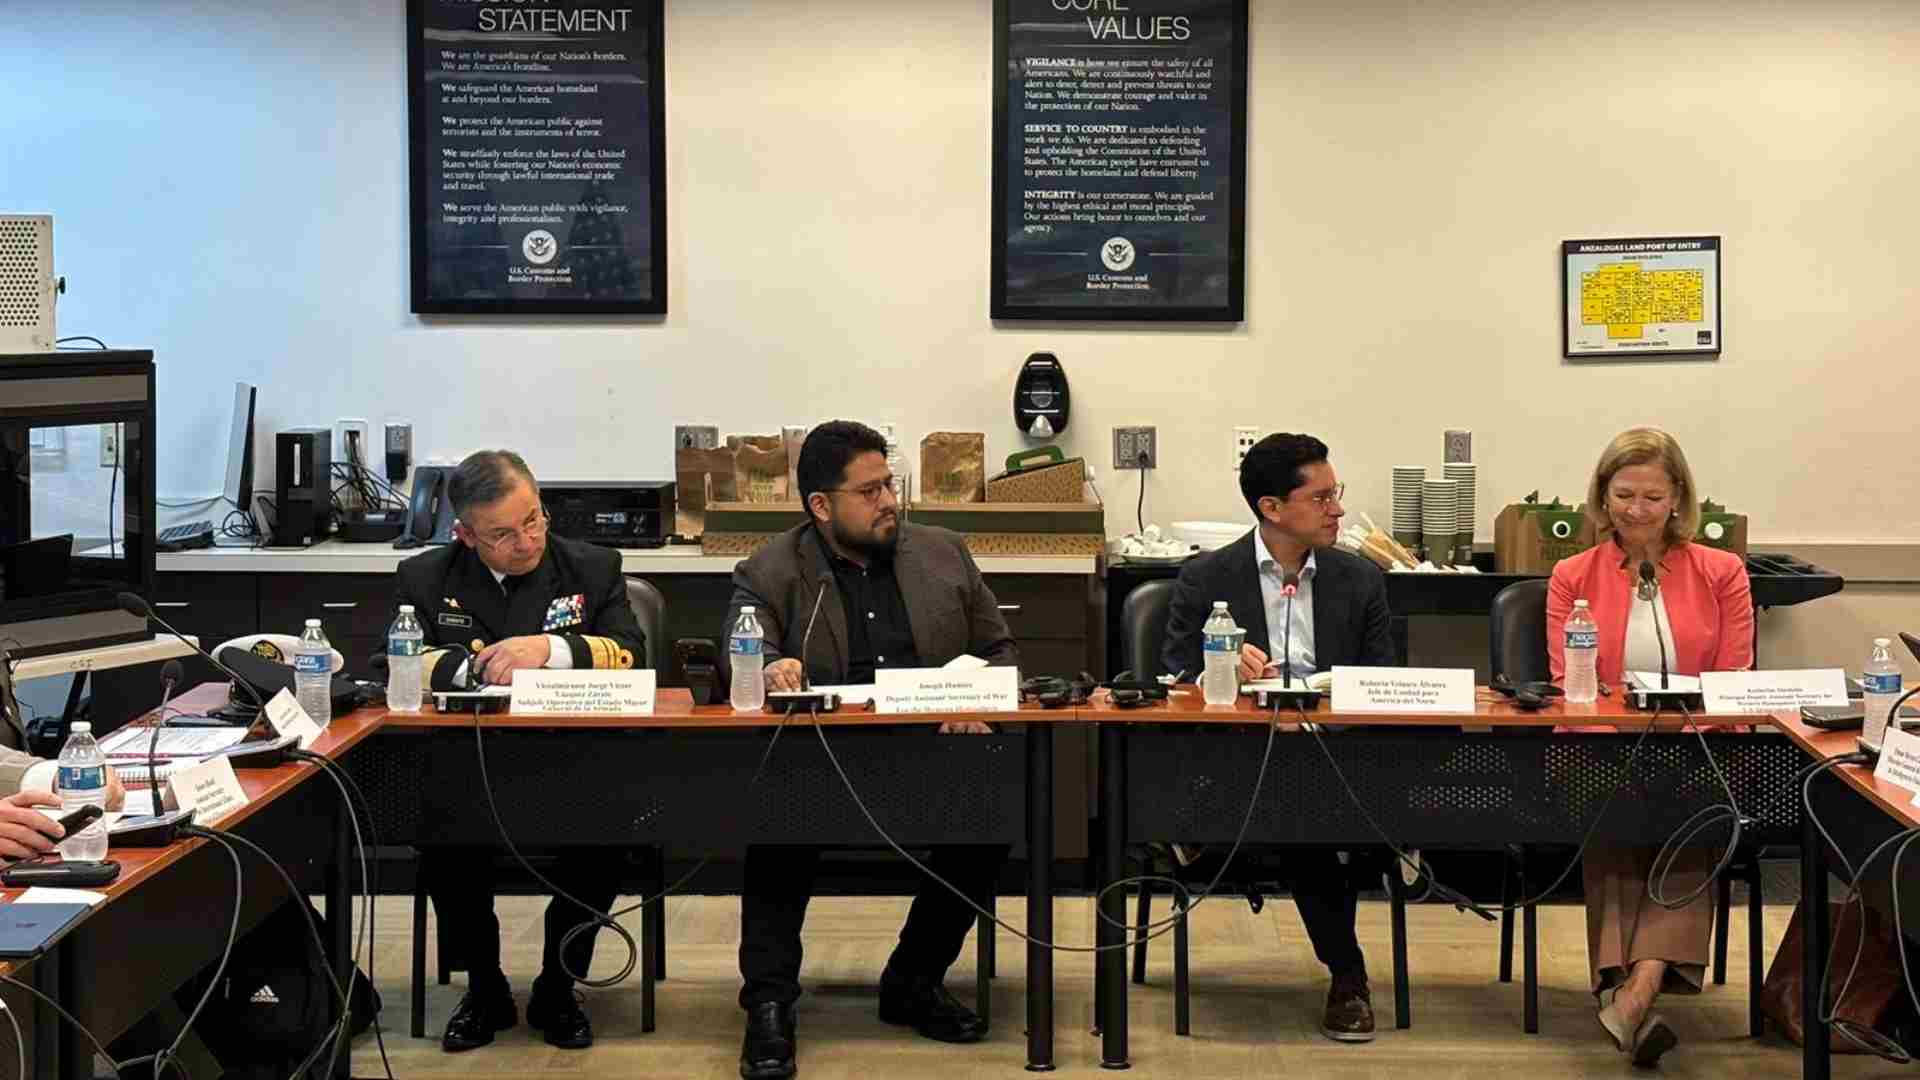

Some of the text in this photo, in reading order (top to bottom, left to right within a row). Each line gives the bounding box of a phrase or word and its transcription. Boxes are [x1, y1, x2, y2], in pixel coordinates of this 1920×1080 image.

[478, 8, 632, 32] STATEMENT
[1086, 16, 1190, 40] VALUES
[488, 51, 627, 61] guardians Nation's borders.
[1026, 58, 1076, 67] VIGILANCE
[1086, 58, 1104, 67] how
[1152, 58, 1165, 67] the
[1168, 58, 1188, 69] safety
[1025, 70, 1210, 80] Americans. continuously watchful and
[458, 84, 598, 94] safeguard the American homeland
[1124, 81, 1154, 90] prevent
[470, 95, 552, 105] beyond borders.
[1025, 92, 1054, 100] Nation.
[1124, 93, 1155, 102] courage
[1158, 92, 1172, 100] and
[1024, 102, 1140, 112] the protection Nation.
[460, 116, 602, 127] protect the American public against
[442, 128, 479, 136] terrorists
[482, 128, 496, 136] and
[499, 128, 510, 136] the
[514, 128, 562, 136] instruments
[1024, 124, 1206, 134] SERVICE TO COUNTRY embodied the
[1025, 136, 1200, 146] work dedicated defending
[503, 149, 533, 158] enforce
[536, 149, 548, 158] the
[552, 149, 570, 158] laws
[582, 149, 596, 158] the
[598, 149, 626, 158] United
[1025, 146, 1206, 156] and upholding the Constitution the United
[443, 160, 465, 169] States
[468, 160, 490, 169] while
[494, 160, 528, 171] fostering
[548, 160, 580, 169] Nation's
[1052, 158, 1066, 166] The
[1069, 158, 1108, 166] American
[1110, 158, 1136, 168] people
[1140, 158, 1158, 166] have
[443, 172, 474, 182] security
[478, 172, 510, 182] through
[513, 172, 538, 180] lawful
[541, 172, 592, 180] international
[1035, 168, 1199, 178] protect the homeland and defend liberty.
[443, 182, 486, 190] and travel.
[1024, 190, 1076, 199] INTEGRITY
[1185, 190, 1214, 201] guided
[484, 204, 496, 212] the
[500, 204, 538, 212] American
[542, 204, 566, 214] public
[568, 204, 586, 212] with
[1038, 202, 1195, 212] the highest ethical and moral principles.
[443, 214, 478, 224] integrity
[480, 214, 496, 222] and
[1024, 213, 1188, 223] Our actions bring honor ourselves and
[1024, 225, 1052, 233] agency.
